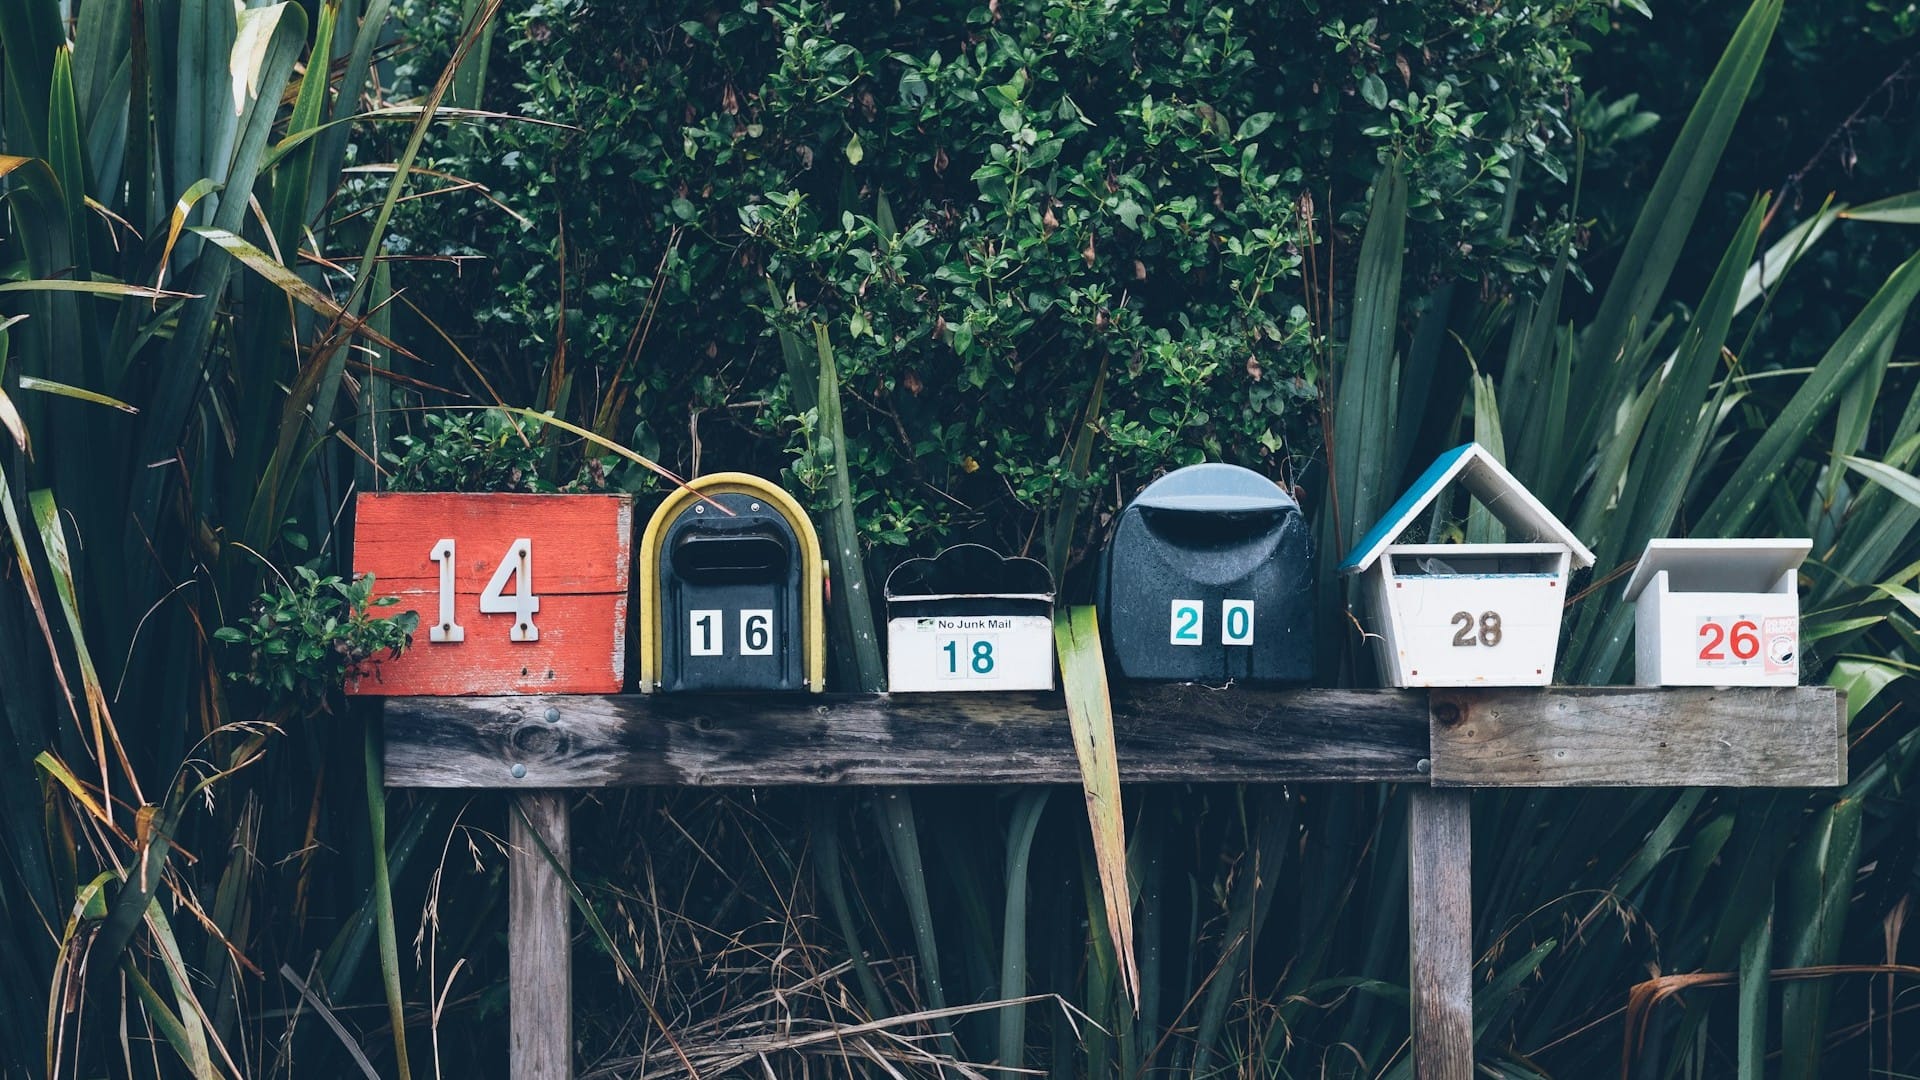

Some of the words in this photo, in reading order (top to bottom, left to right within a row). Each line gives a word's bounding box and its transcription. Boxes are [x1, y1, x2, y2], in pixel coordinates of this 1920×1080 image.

[430, 538, 539, 642] 14
[696, 615, 767, 650] 16
[938, 620, 954, 629] No
[957, 620, 985, 629] Junk
[988, 620, 1011, 629] Mail
[1175, 606, 1250, 640] 20
[1450, 610, 1503, 647] 28
[1699, 620, 1760, 660] 26
[943, 640, 994, 673] 18
